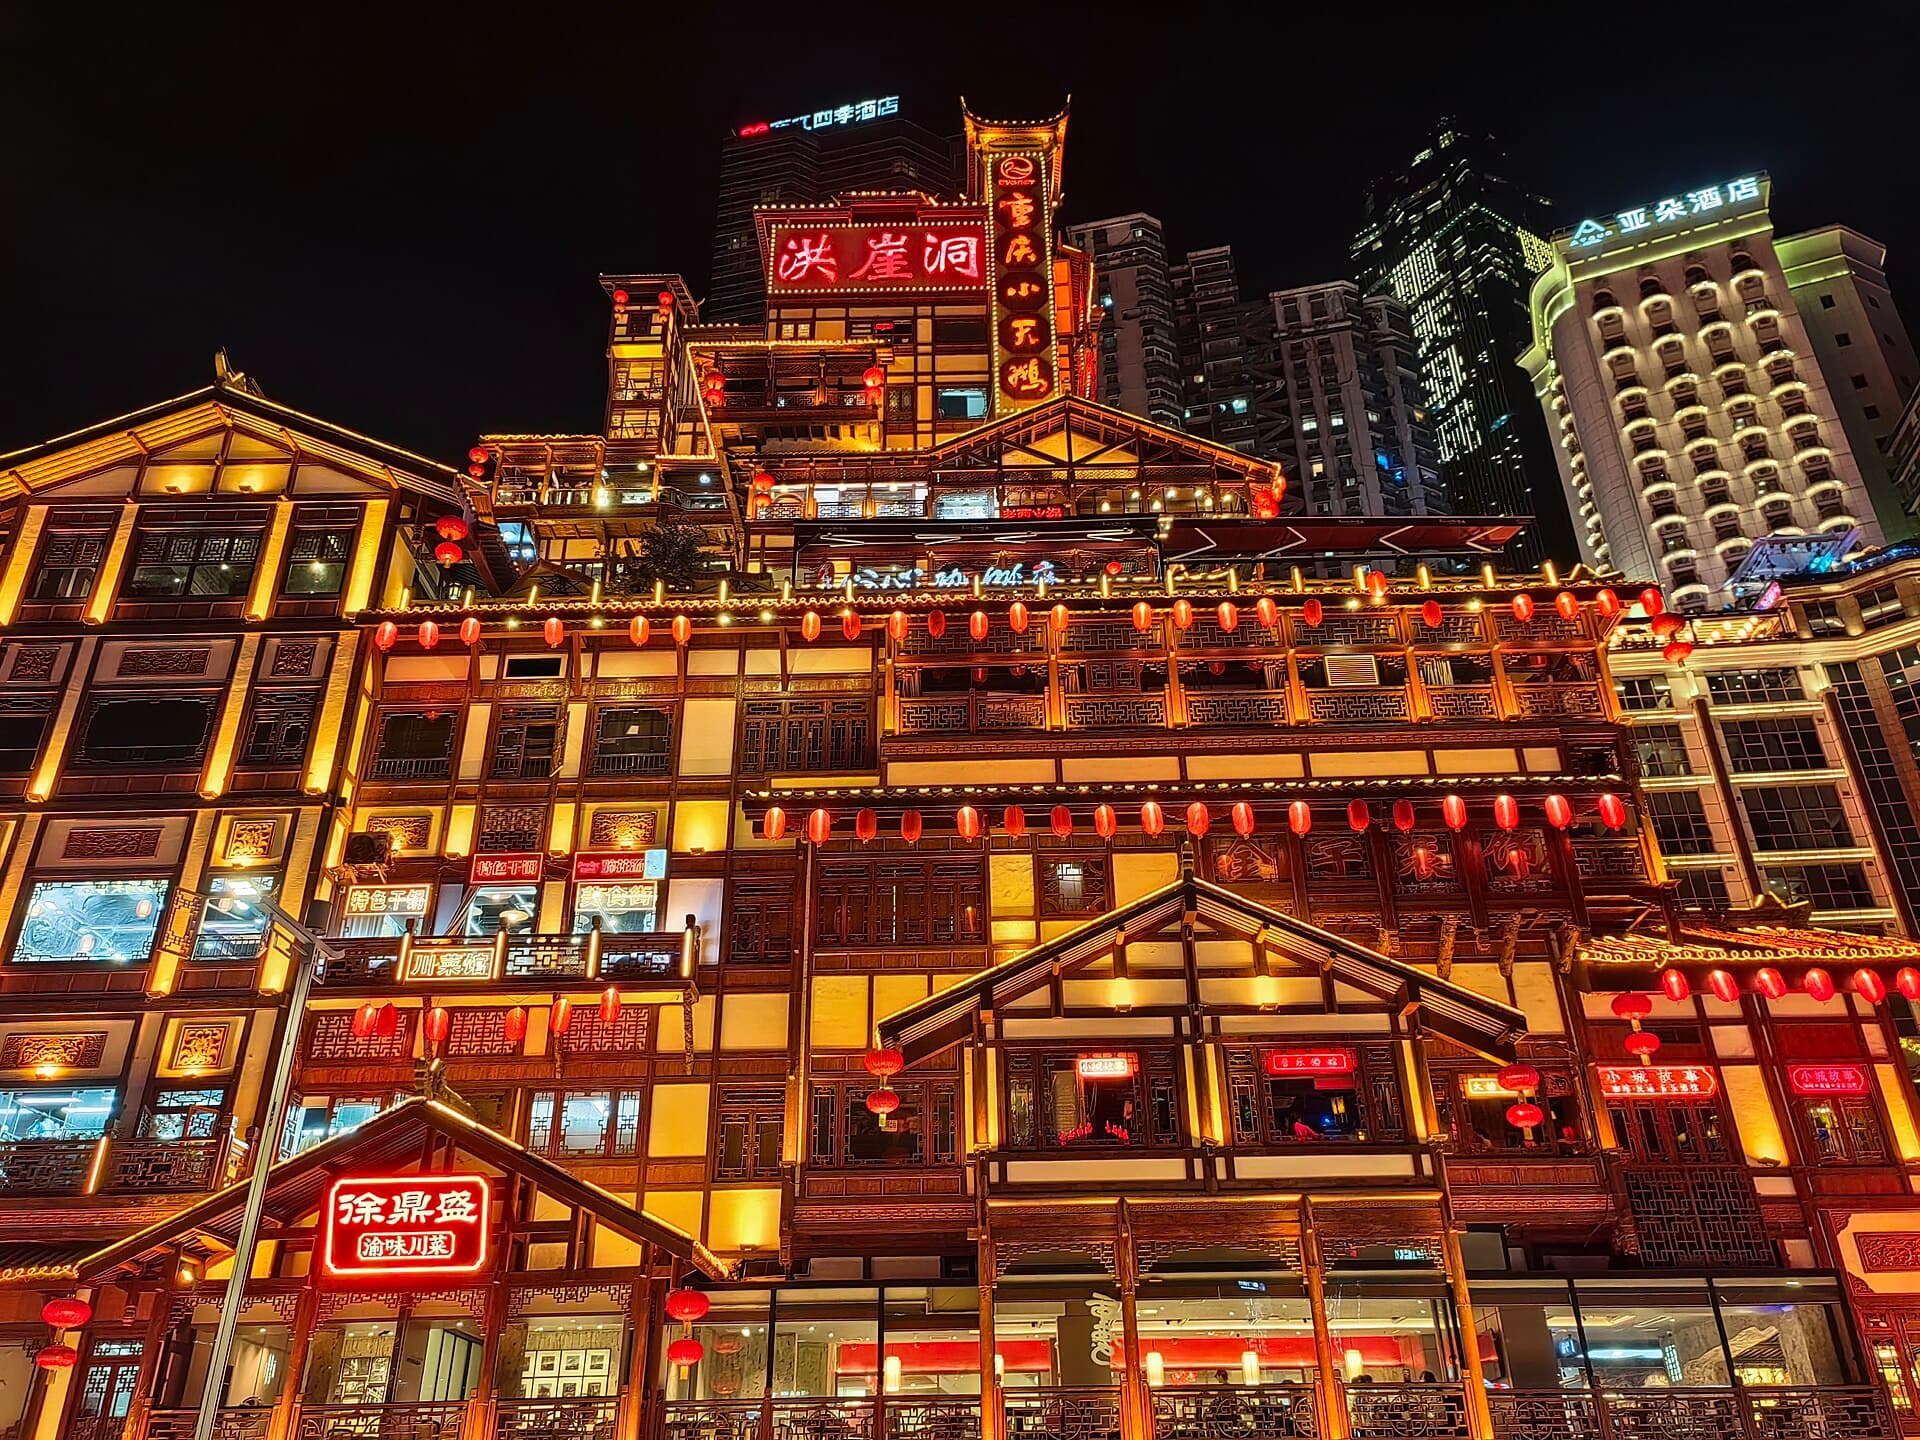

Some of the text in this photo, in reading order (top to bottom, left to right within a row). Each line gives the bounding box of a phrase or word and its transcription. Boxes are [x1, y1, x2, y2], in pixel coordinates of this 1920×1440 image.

[1617, 176, 1760, 234] 亚朵酒店
[778, 232, 979, 284] 洪崖洞
[999, 192, 1048, 392] 重庆小天鹅
[351, 889, 425, 911] 特色干锅
[580, 885, 653, 907] 美食街
[410, 952, 488, 976] 川菜馆
[1606, 1070, 1700, 1083] 小城故事
[1801, 1070, 1856, 1082] 小城故事
[338, 1190, 478, 1225] 徐鼎盛
[362, 1234, 449, 1257] 渝味川菜
